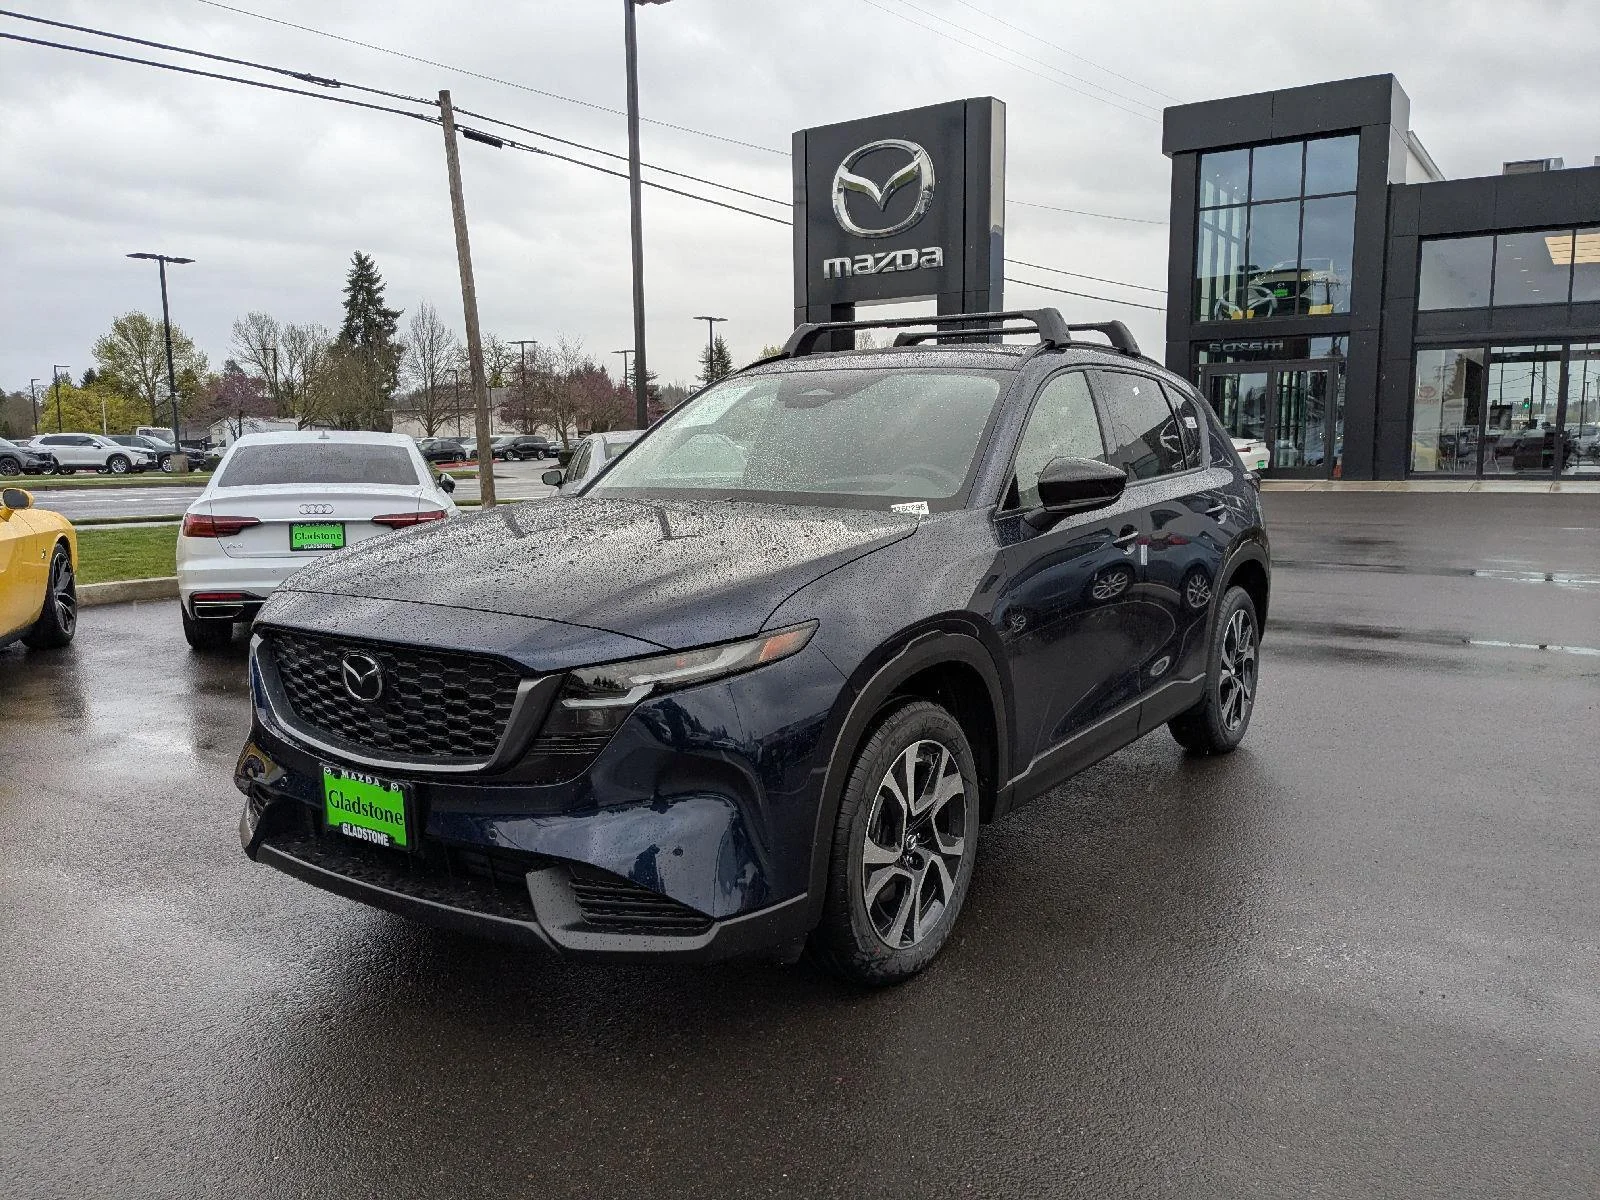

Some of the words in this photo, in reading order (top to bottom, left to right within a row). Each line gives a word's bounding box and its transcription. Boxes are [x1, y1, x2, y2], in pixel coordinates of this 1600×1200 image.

[823, 247, 943, 280] mazda
[294, 532, 342, 541] Gladstone
[341, 769, 381, 787] MAZDA
[328, 789, 404, 826] Gladstone
[342, 822, 390, 847] GLADSTONE
